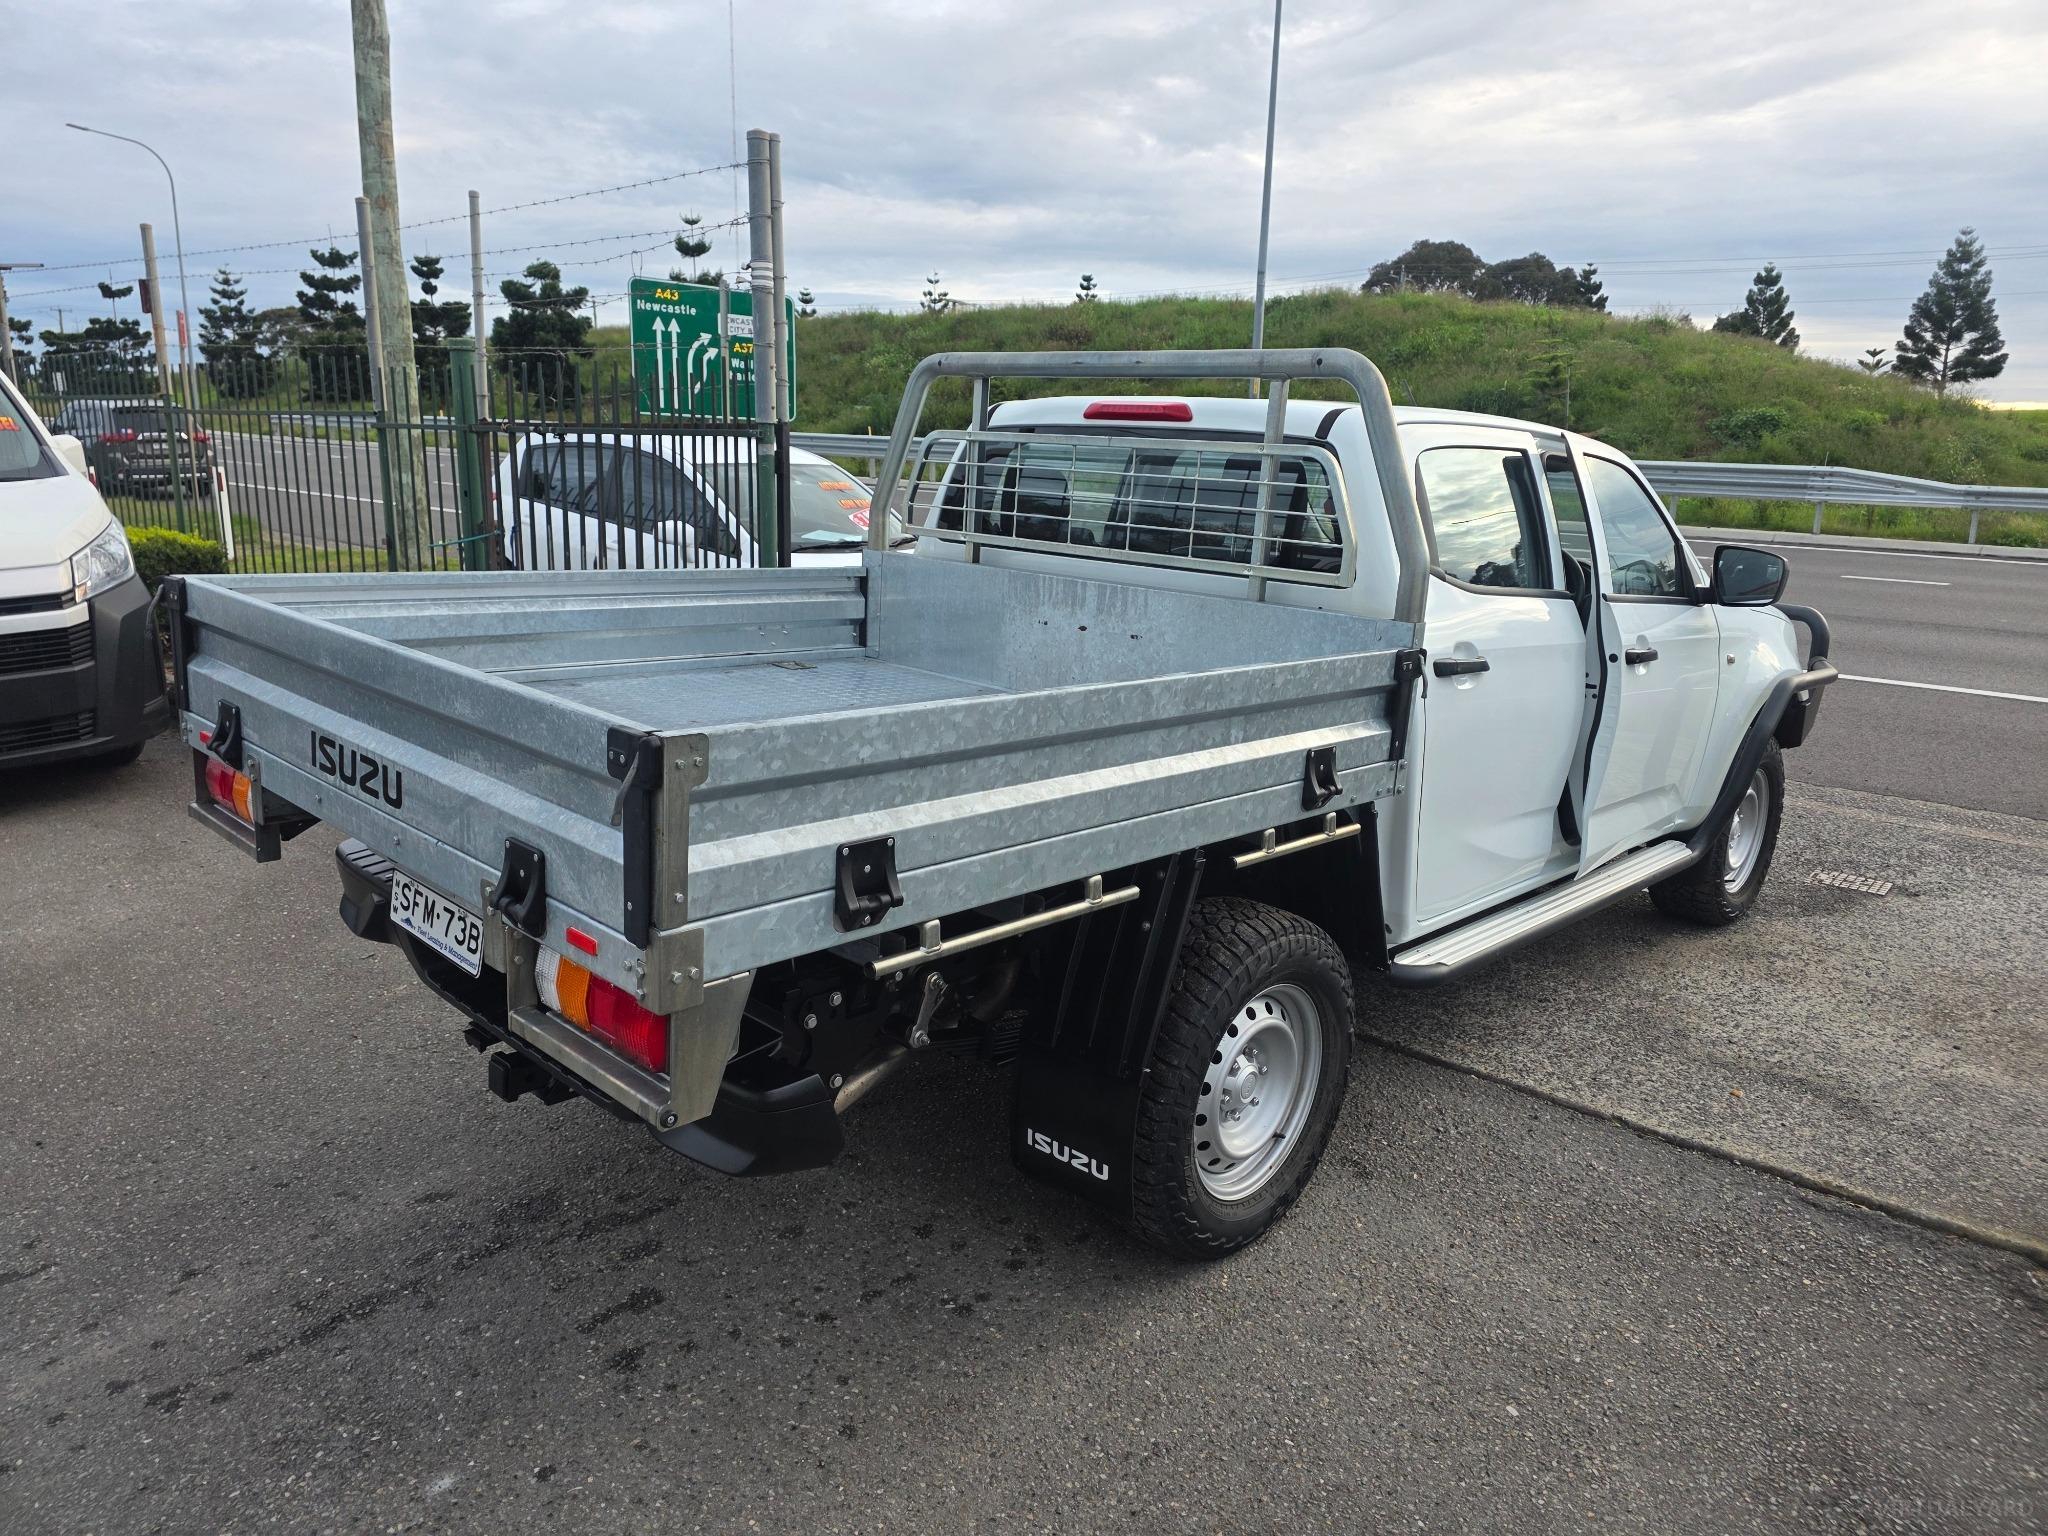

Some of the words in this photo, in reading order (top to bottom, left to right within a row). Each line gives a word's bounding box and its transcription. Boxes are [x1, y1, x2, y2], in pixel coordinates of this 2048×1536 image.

[637, 299, 696, 315] Newcastle
[655, 288, 679, 300] A43
[311, 730, 403, 810] ISUZU
[1027, 1127, 1109, 1181] ISUZU
